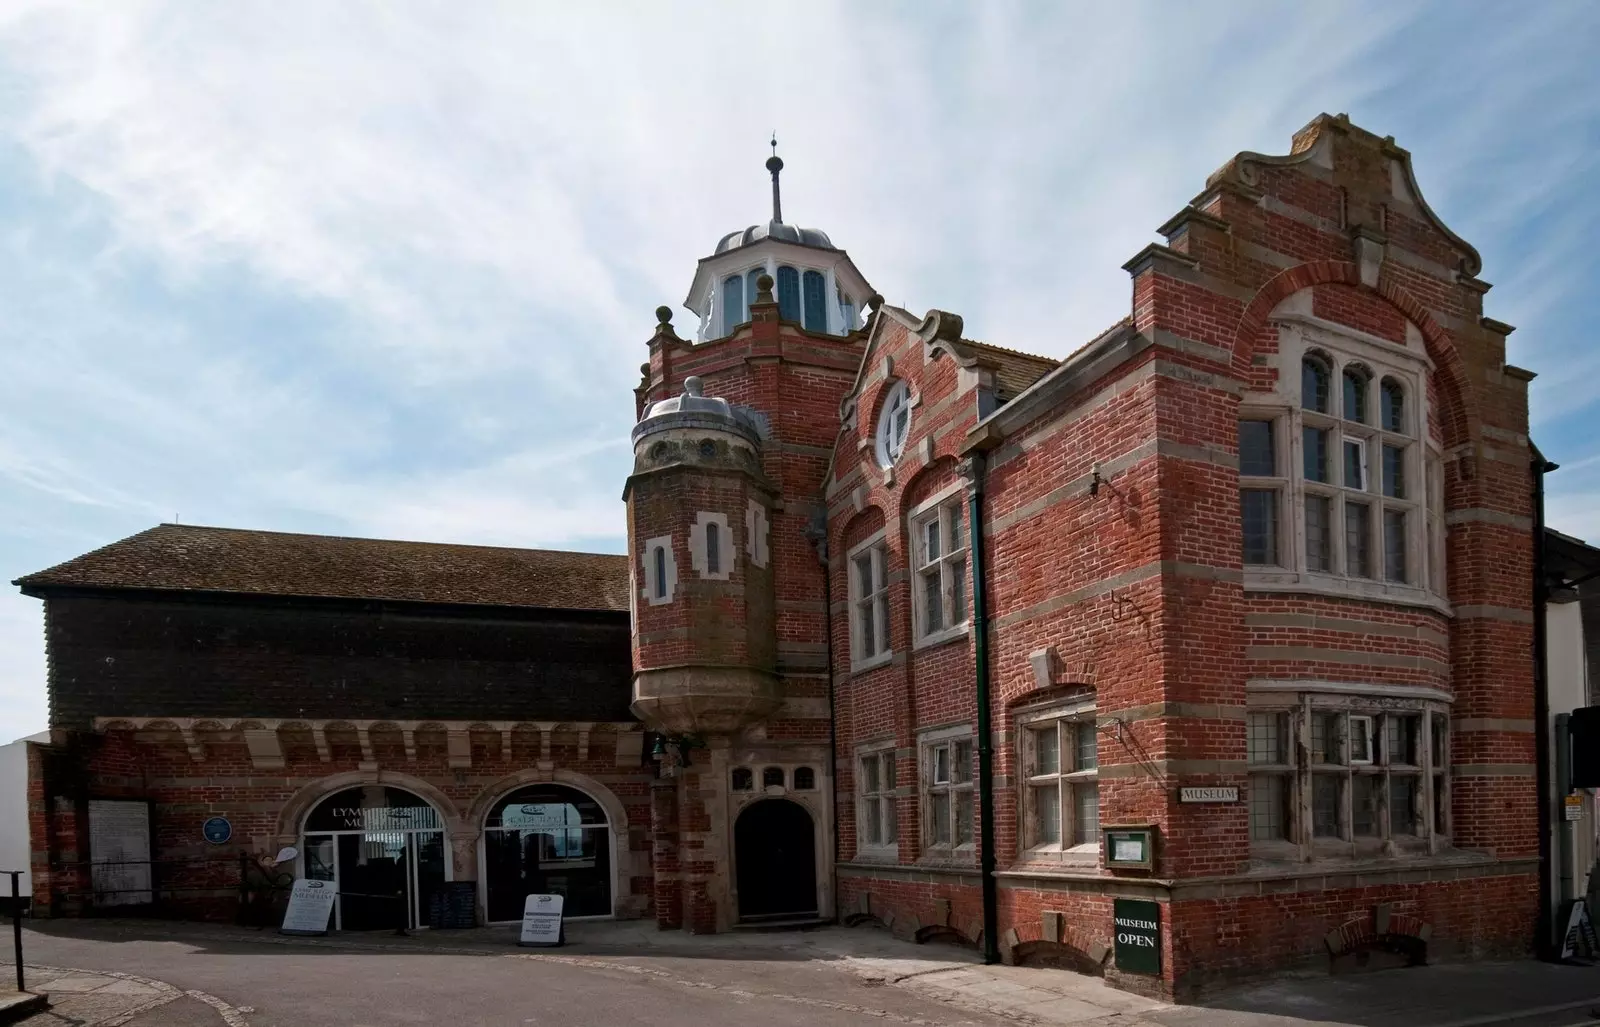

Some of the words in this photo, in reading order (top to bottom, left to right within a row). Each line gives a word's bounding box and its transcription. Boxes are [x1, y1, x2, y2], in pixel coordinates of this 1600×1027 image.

[1184, 789, 1235, 799] MUSEUM
[332, 807, 367, 817] LYM
[1115, 917, 1157, 930] MUSEUM
[1118, 932, 1154, 947] OPEN
